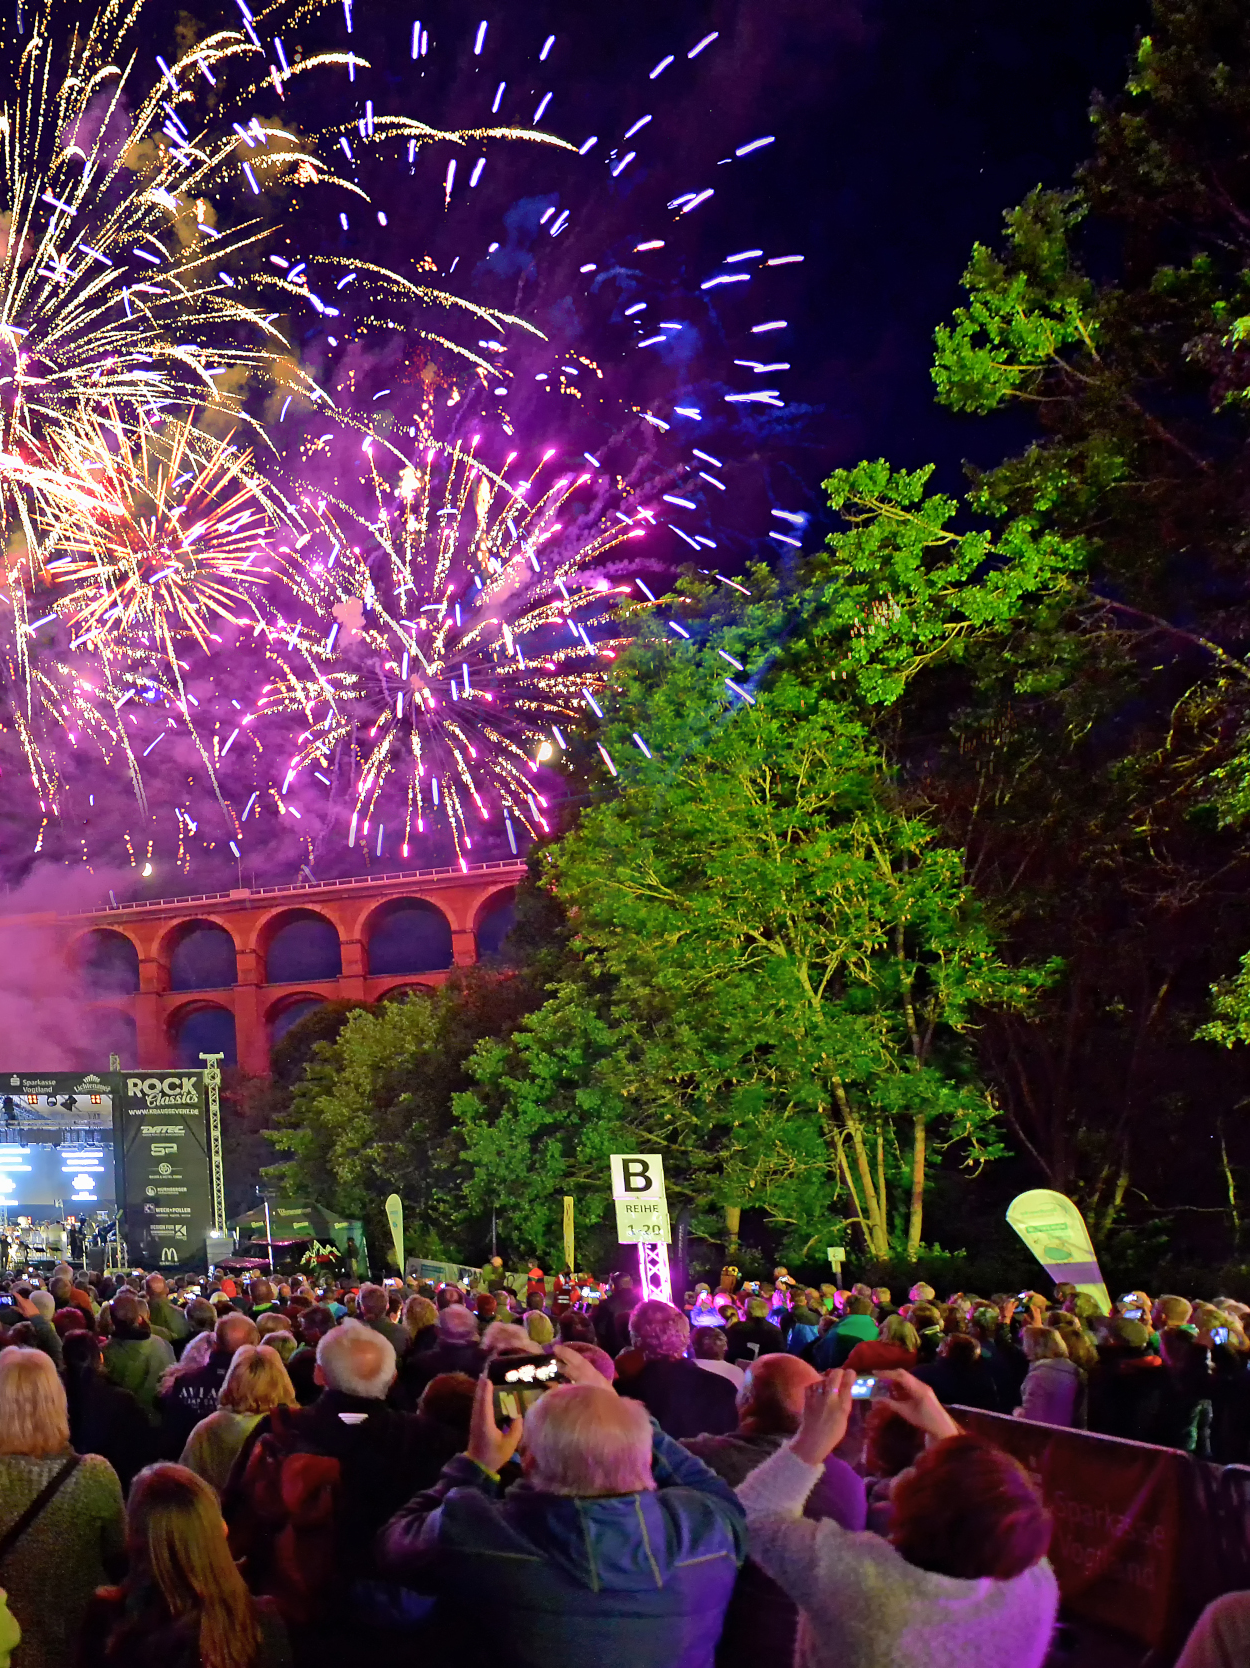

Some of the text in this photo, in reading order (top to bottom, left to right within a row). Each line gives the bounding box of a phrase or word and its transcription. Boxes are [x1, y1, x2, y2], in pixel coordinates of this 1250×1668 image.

[22, 1079, 56, 1087] Sparkasse
[127, 1077, 198, 1097] ROCK
[22, 1086, 53, 1095] Vogtland
[146, 1092, 198, 1107] Classics
[622, 1158, 653, 1193] B
[625, 1204, 659, 1213] REIHE
